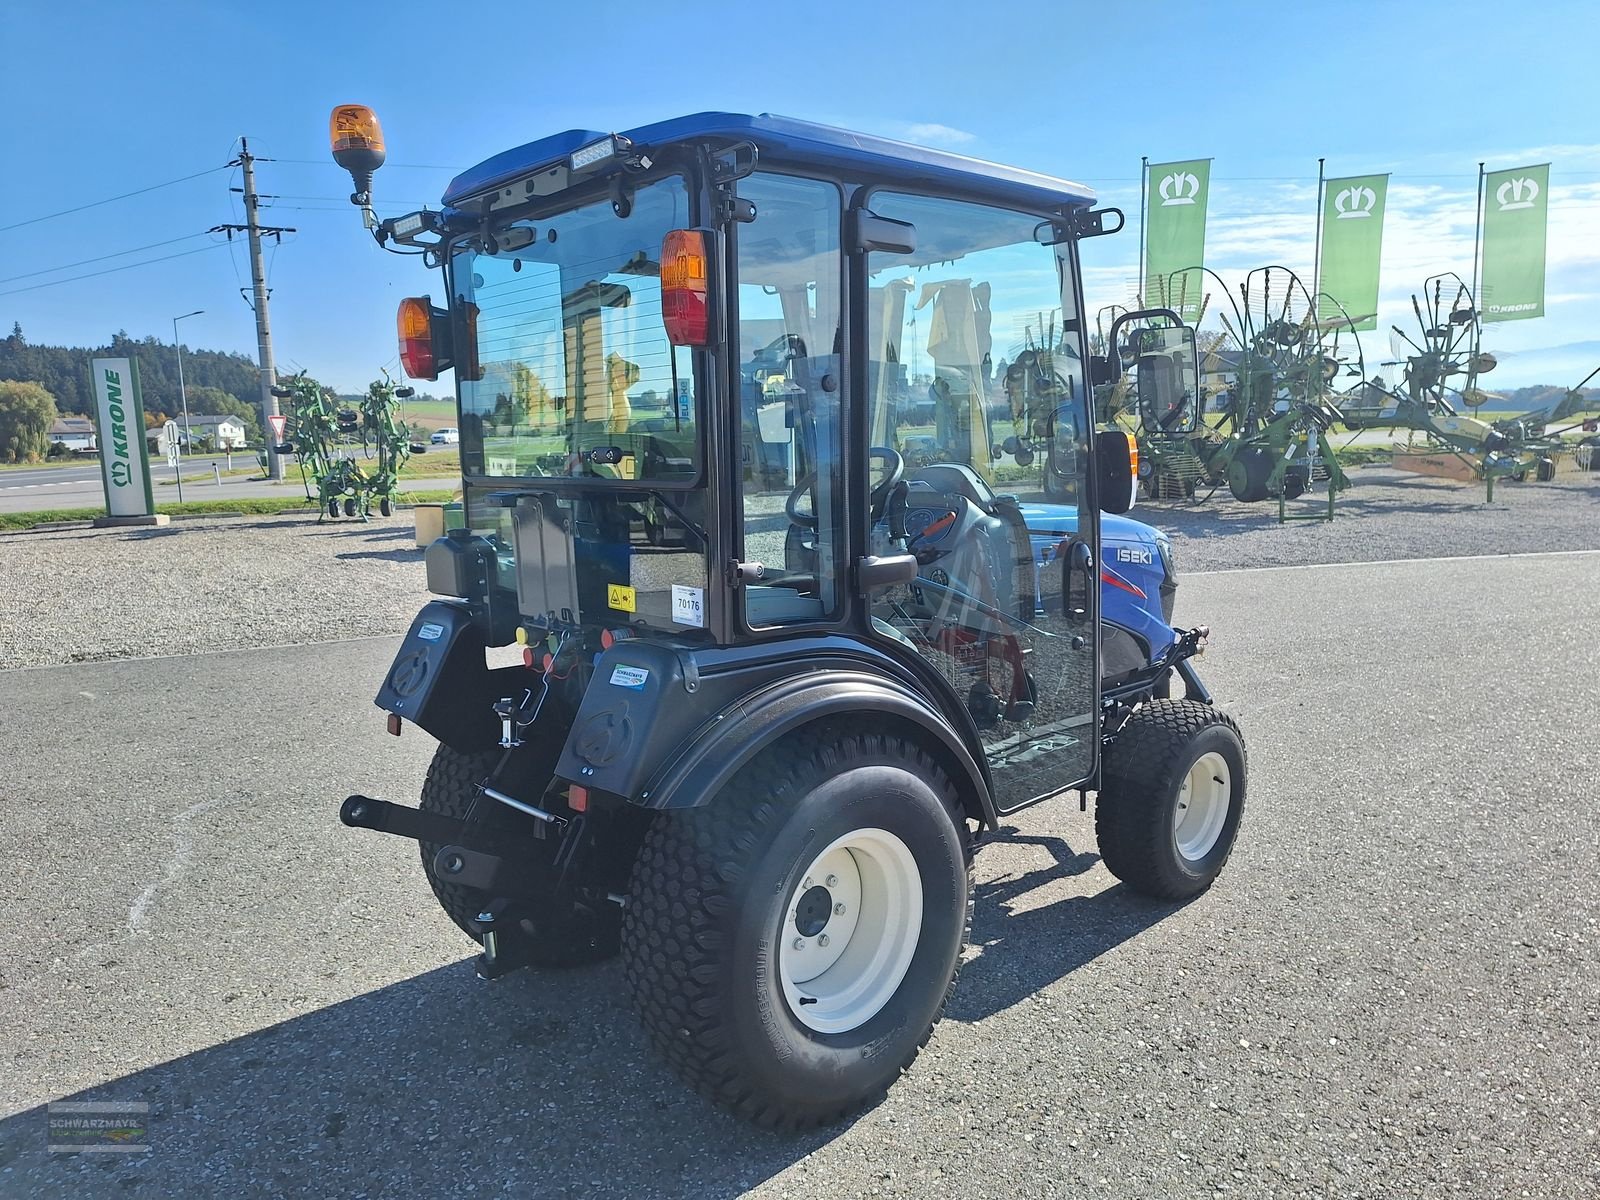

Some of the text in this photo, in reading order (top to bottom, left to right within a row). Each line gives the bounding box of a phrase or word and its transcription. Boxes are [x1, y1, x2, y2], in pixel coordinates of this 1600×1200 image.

[1500, 303, 1538, 312] KRONE
[105, 369, 129, 458] KRONE
[1117, 549, 1152, 565] ISEKI
[678, 598, 700, 611] 70176
